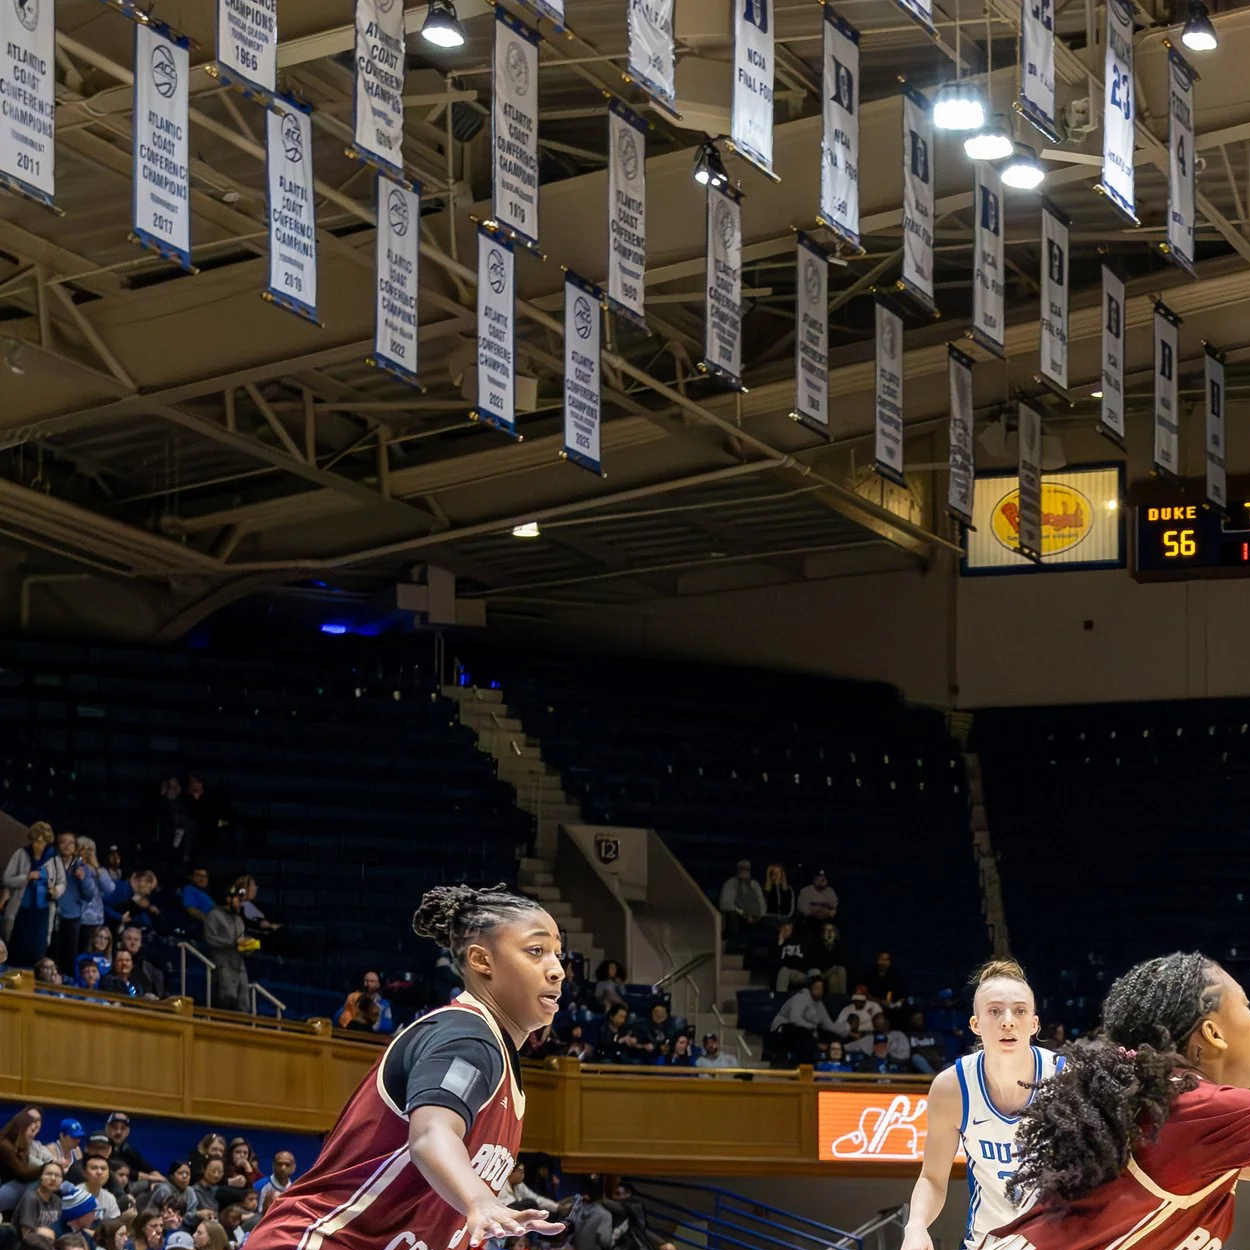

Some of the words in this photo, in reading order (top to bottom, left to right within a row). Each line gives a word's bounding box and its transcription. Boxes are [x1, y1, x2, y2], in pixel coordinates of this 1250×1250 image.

[7, 42, 46, 76] ATLANTIC
[371, 44, 399, 70] COAST
[747, 48, 767, 73] NCAA
[14, 66, 40, 93] COAST
[1110, 63, 1131, 121] 23
[2, 100, 53, 139] CHAMPIONS
[149, 111, 182, 141] ATLANTIC
[153, 132, 176, 156] COAST
[17, 152, 40, 176] 2011
[143, 164, 187, 200] CHAMPIONS
[153, 213, 173, 235] 2017
[1147, 506, 1197, 521] DUKE
[1163, 529, 1196, 556] 56
[601, 841, 618, 859] 12
